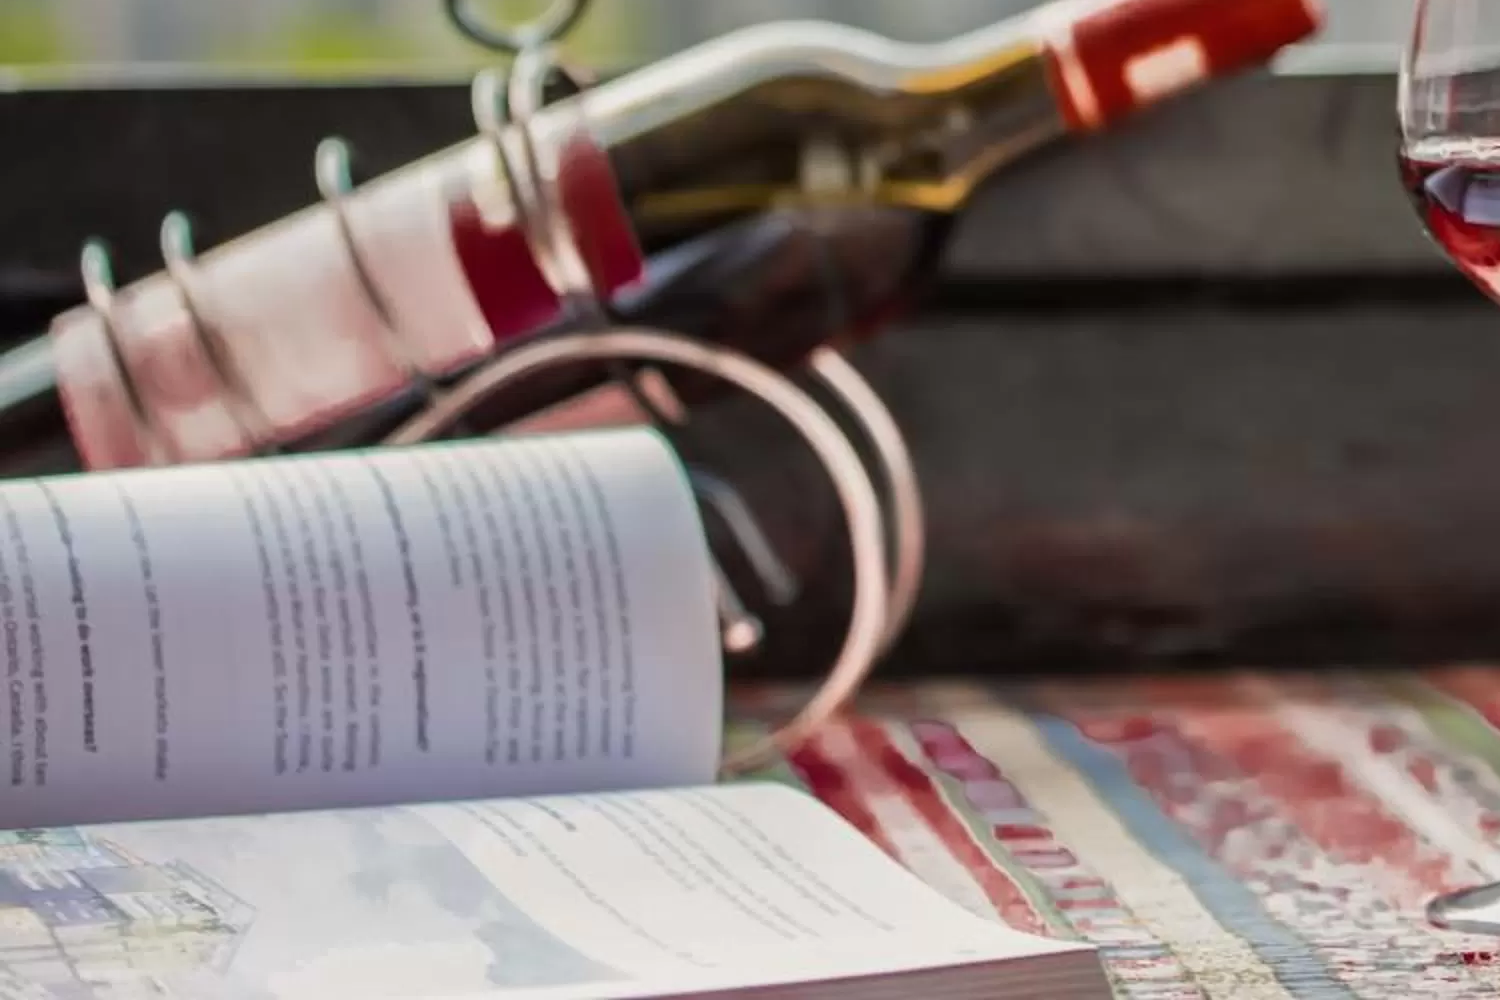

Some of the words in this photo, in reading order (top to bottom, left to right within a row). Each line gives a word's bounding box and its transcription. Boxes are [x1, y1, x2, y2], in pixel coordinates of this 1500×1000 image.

[5, 620, 20, 677] Ontario,
[30, 623, 45, 678] working
[80, 644, 94, 678] work
[34, 682, 48, 713] with
[83, 681, 99, 753] overseas?
[35, 718, 49, 757] about
